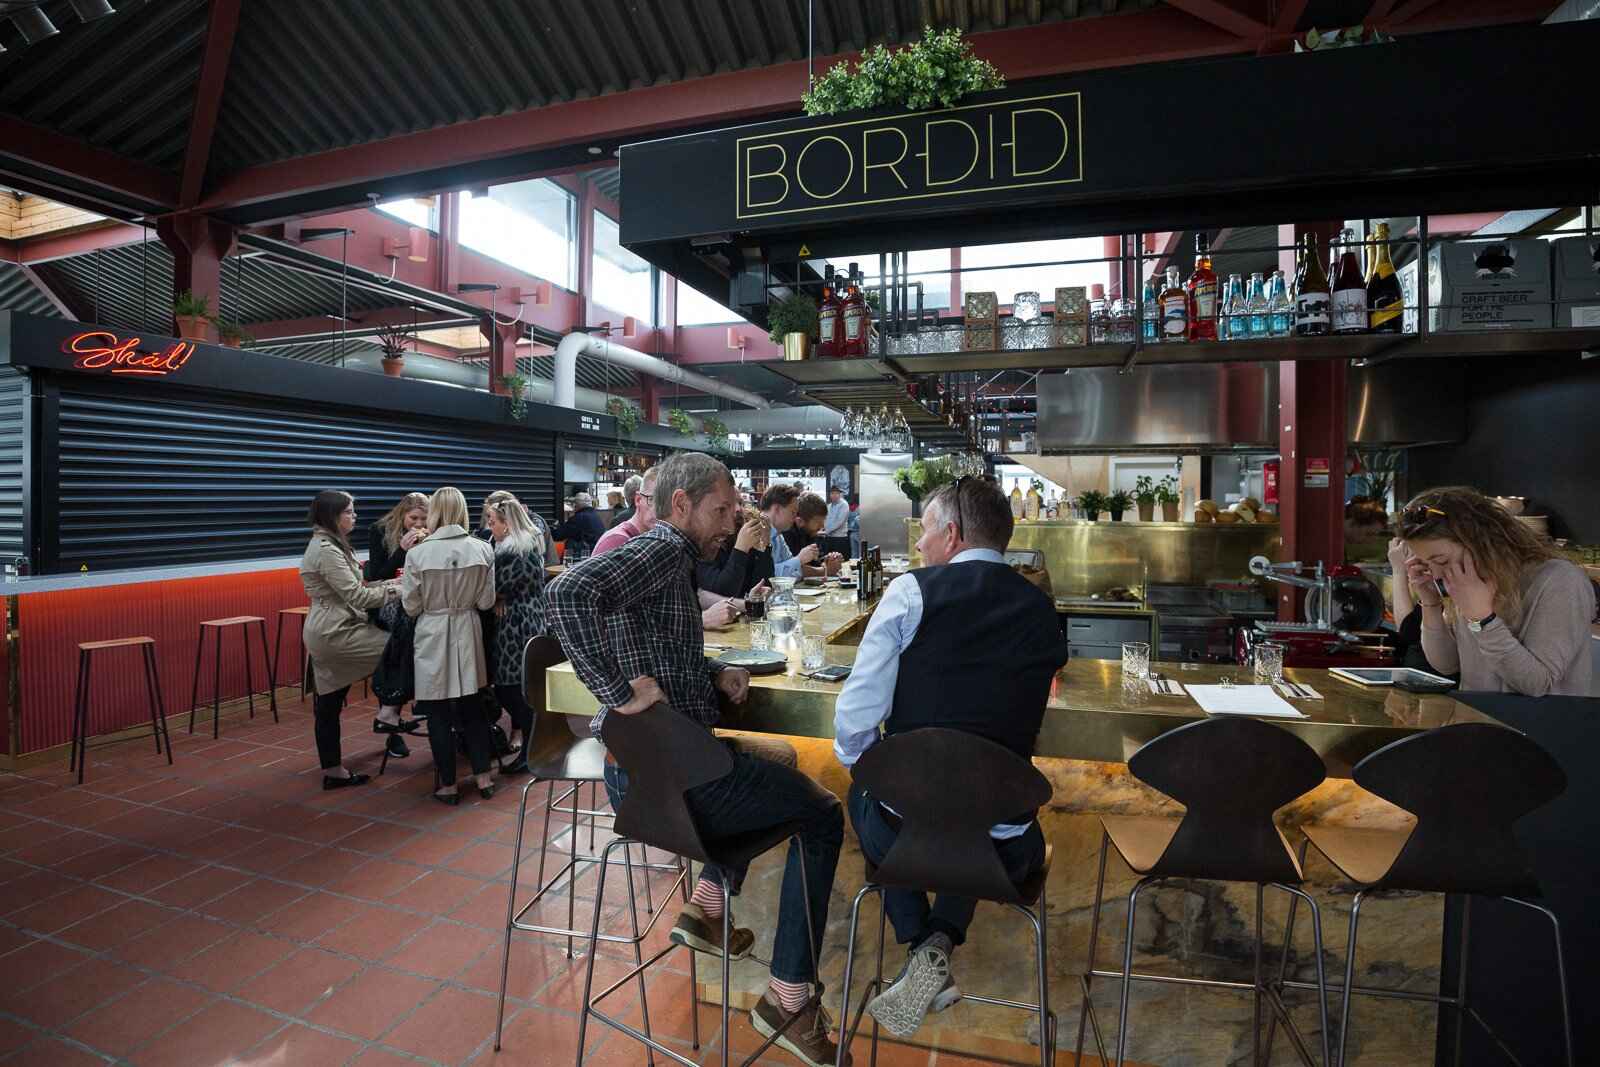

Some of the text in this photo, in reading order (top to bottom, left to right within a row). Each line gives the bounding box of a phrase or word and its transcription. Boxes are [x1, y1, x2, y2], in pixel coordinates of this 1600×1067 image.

[1461, 294, 1528, 304] CRAFT BEER
[1461, 311, 1504, 320] PEOPLE
